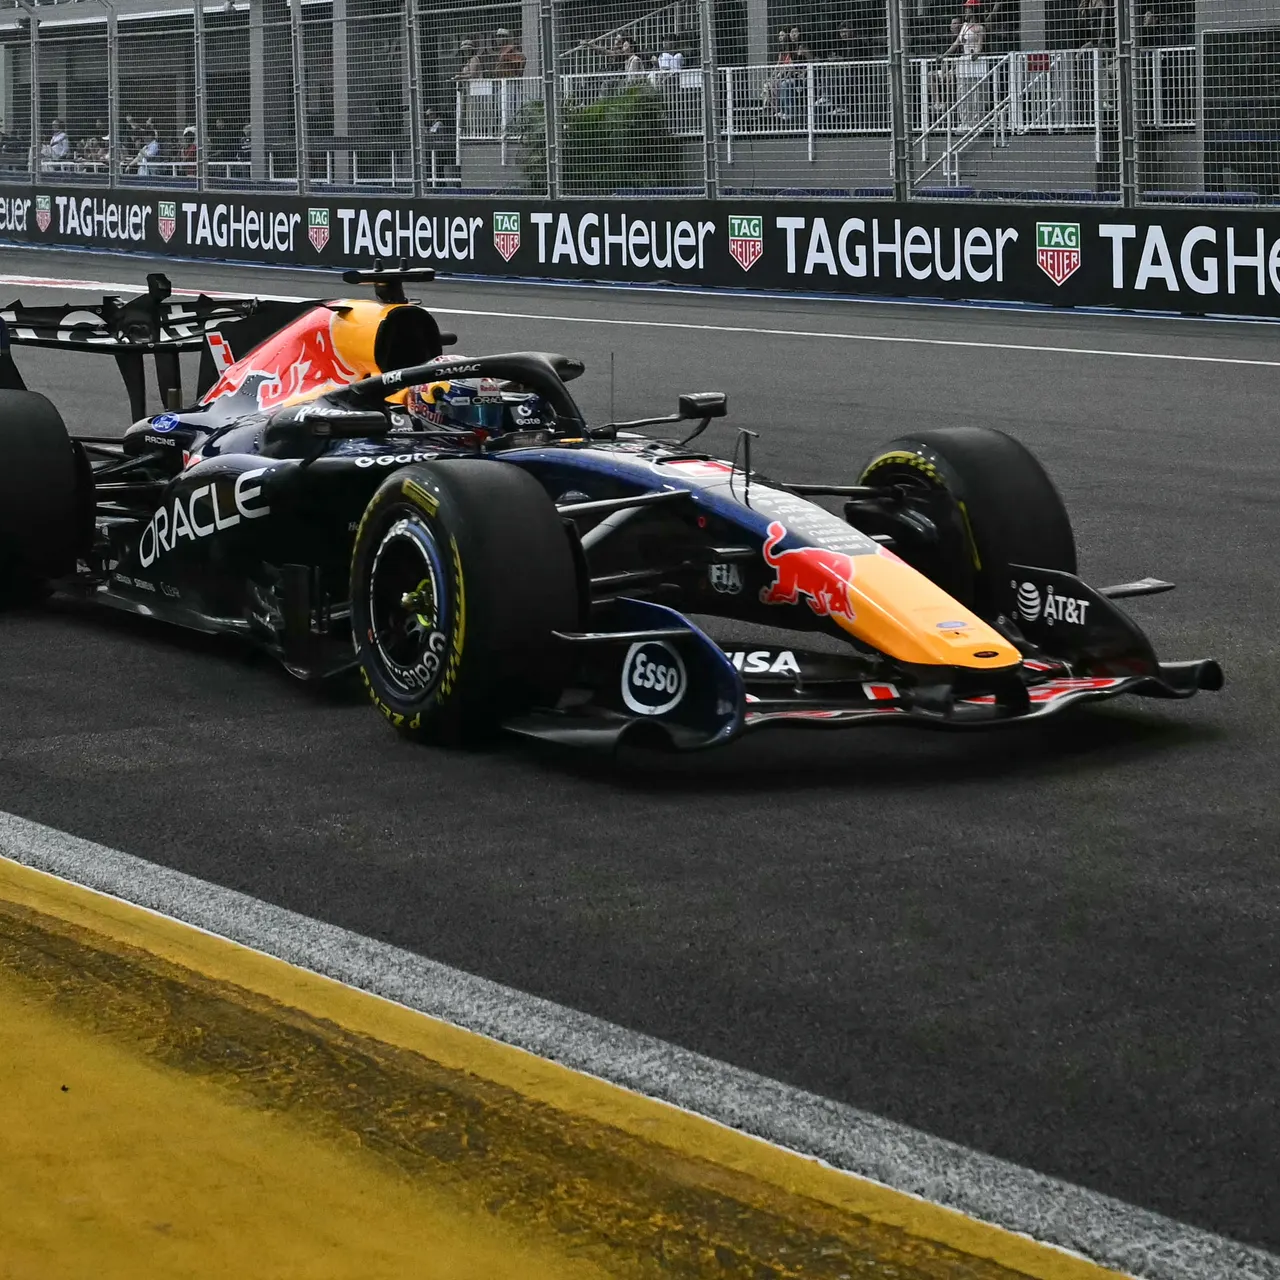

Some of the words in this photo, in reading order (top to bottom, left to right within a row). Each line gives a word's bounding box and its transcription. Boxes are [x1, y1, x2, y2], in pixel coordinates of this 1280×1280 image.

[160, 205, 175, 216] TAG
[310, 211, 329, 225] TAG
[495, 214, 519, 231] TAG
[731, 218, 760, 237] TAG
[308, 227, 329, 250] HEUER
[494, 233, 520, 258] HEUER
[1039, 225, 1078, 247] TAG
[729, 238, 762, 268] HEUER
[1038, 250, 1080, 283] HEUER
[381, 370, 403, 386] VISA
[434, 363, 481, 377] DAMAC
[516, 416, 541, 426] Gate
[144, 435, 176, 447] RACING
[376, 452, 440, 467] Gate
[138, 467, 271, 568] ORACLE
[1043, 593, 1090, 626] AT&T
[724, 650, 802, 674] ISA
